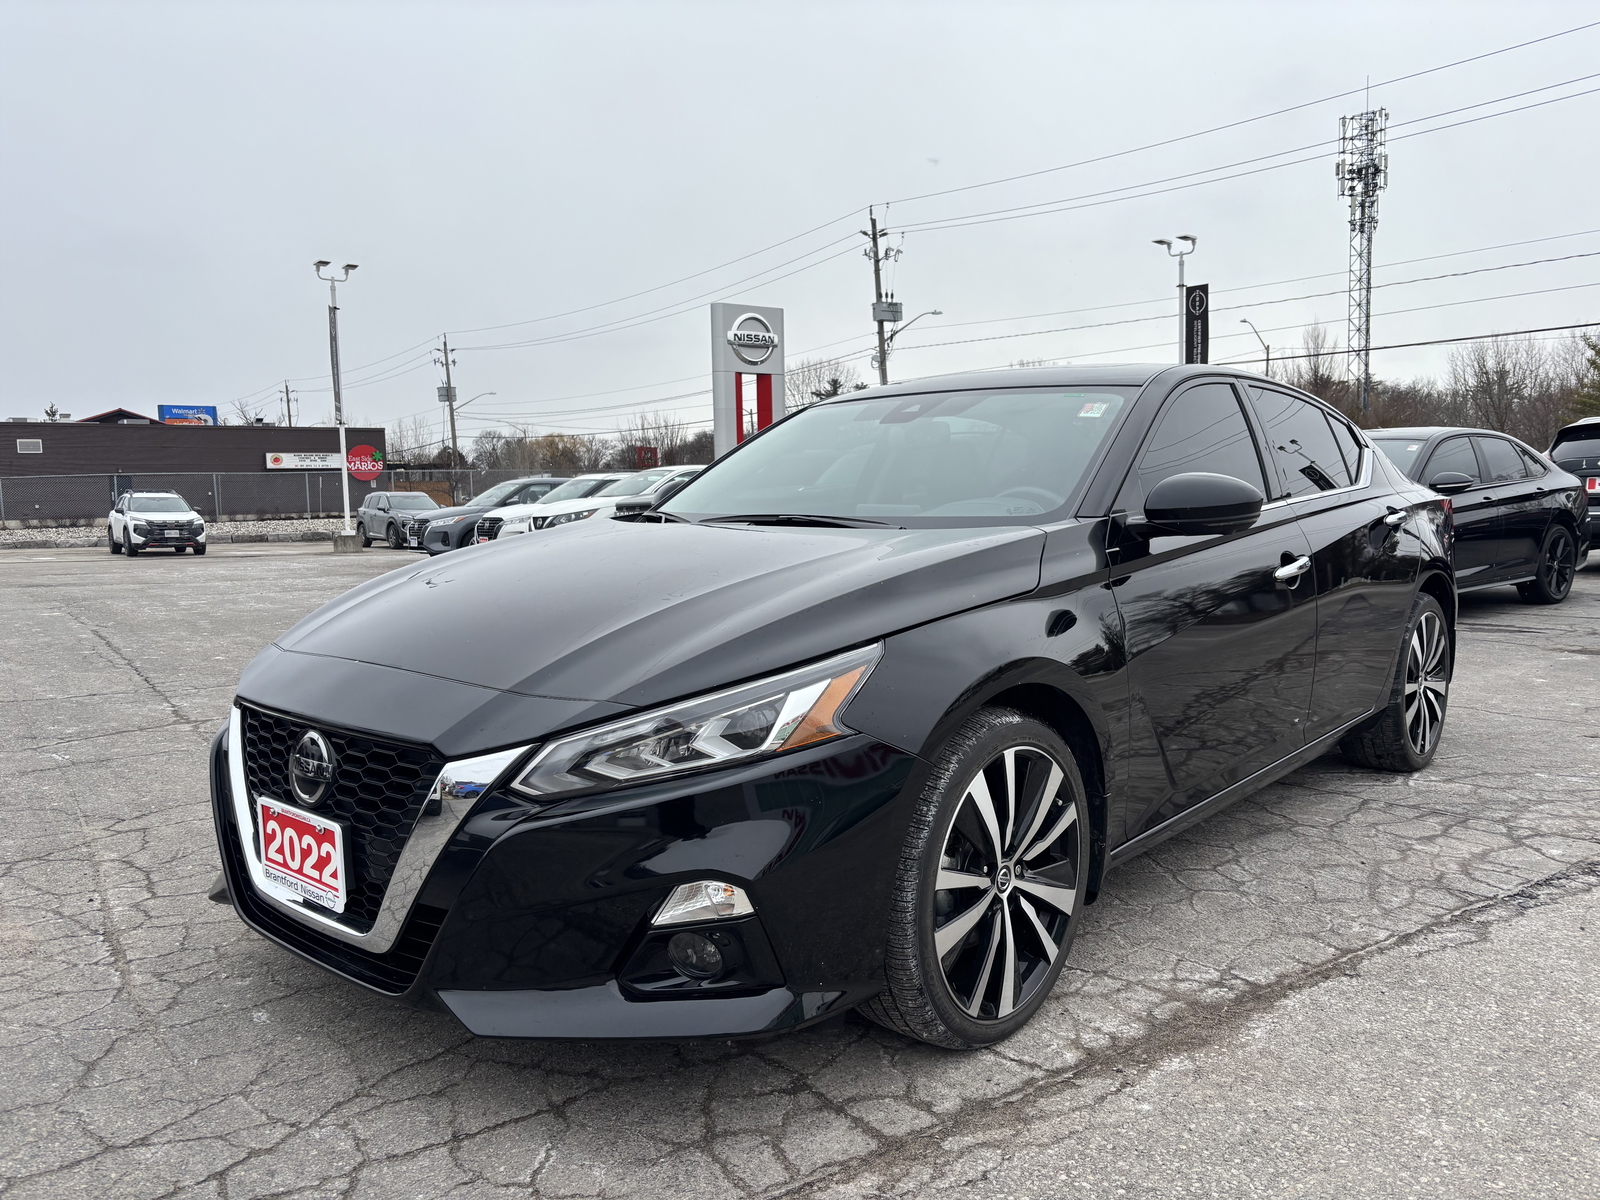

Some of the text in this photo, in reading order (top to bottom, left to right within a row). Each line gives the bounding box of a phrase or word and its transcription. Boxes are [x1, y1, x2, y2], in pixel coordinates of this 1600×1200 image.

[733, 333, 775, 344] NISSAN
[361, 454, 373, 462] Side
[294, 757, 326, 778] NISSAN
[266, 820, 339, 890] 2022
[265, 868, 325, 904] Brantford Nissan
